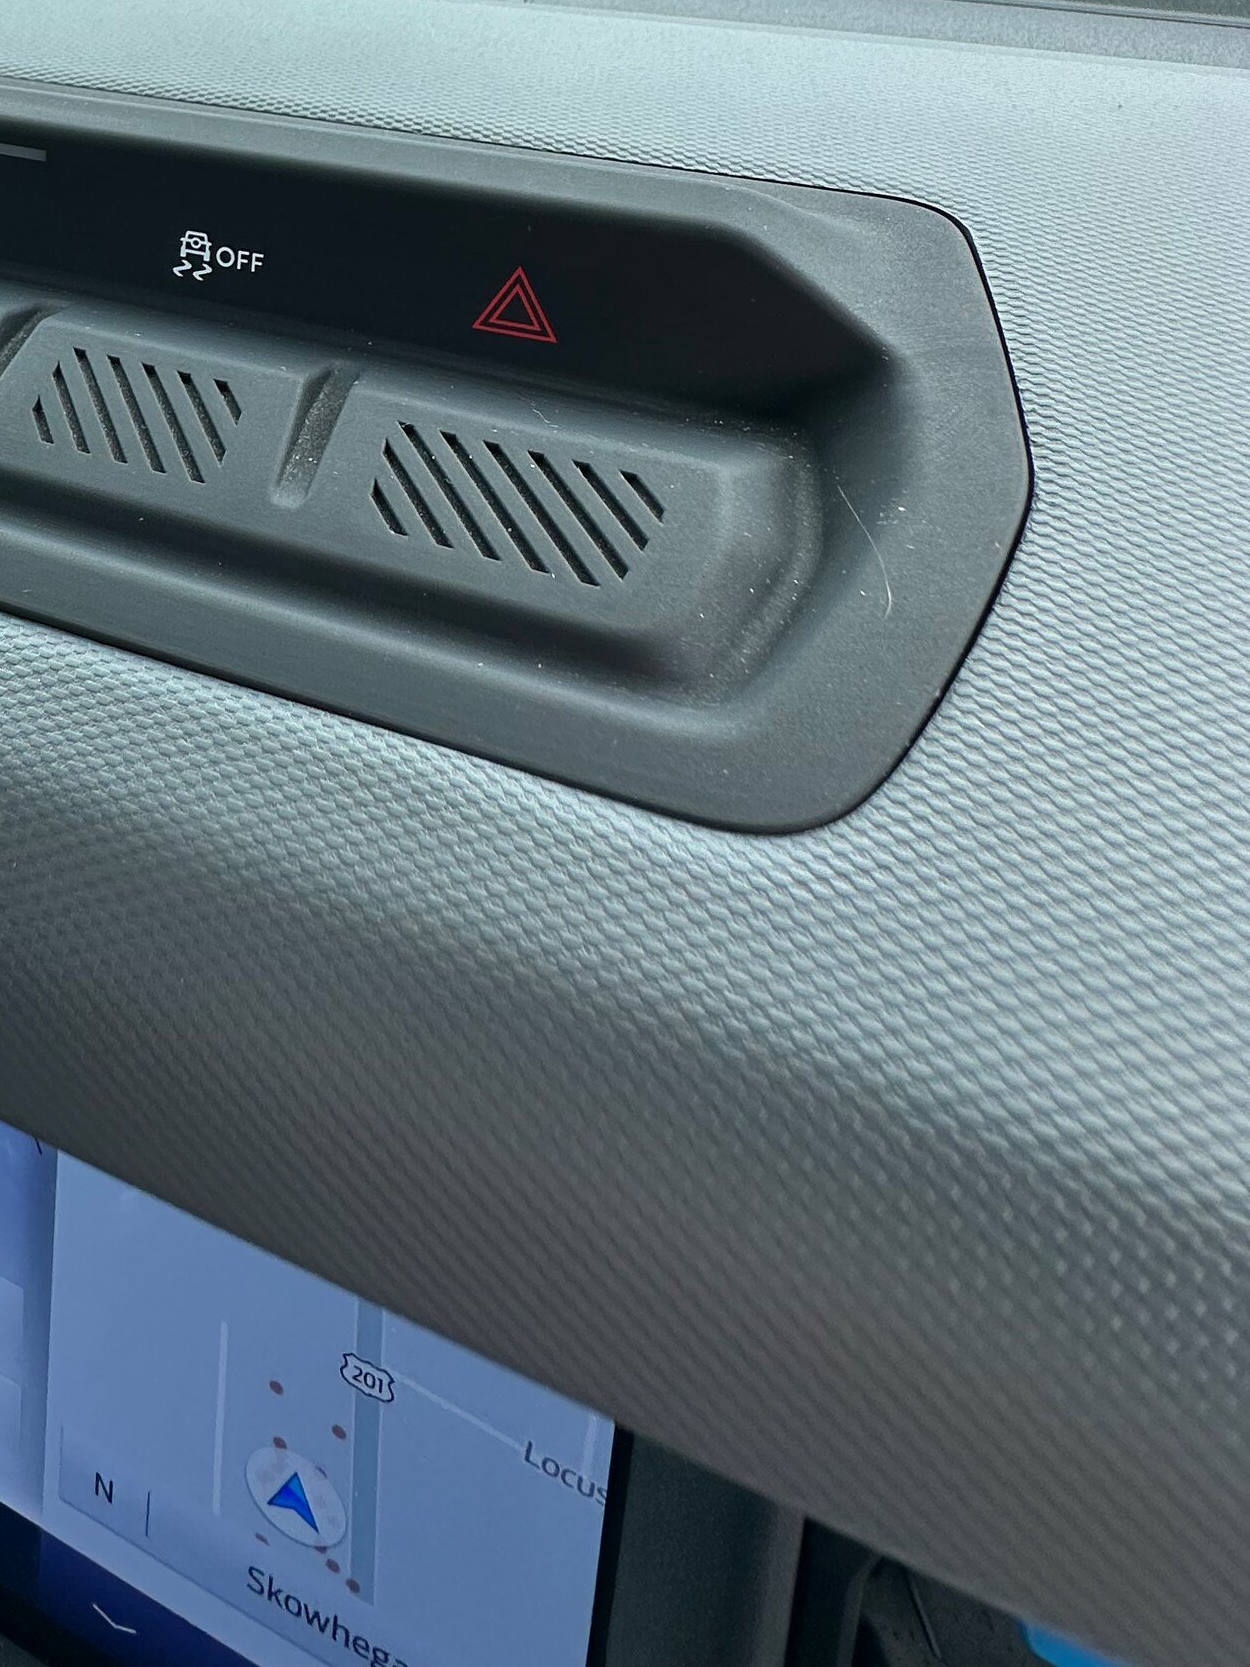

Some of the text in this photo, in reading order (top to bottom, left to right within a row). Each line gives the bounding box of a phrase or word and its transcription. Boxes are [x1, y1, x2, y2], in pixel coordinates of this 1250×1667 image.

[216, 246, 264, 273] OFF
[352, 1364, 383, 1394] 201
[95, 1471, 113, 1504] N
[246, 1566, 409, 1667] Skowheg
